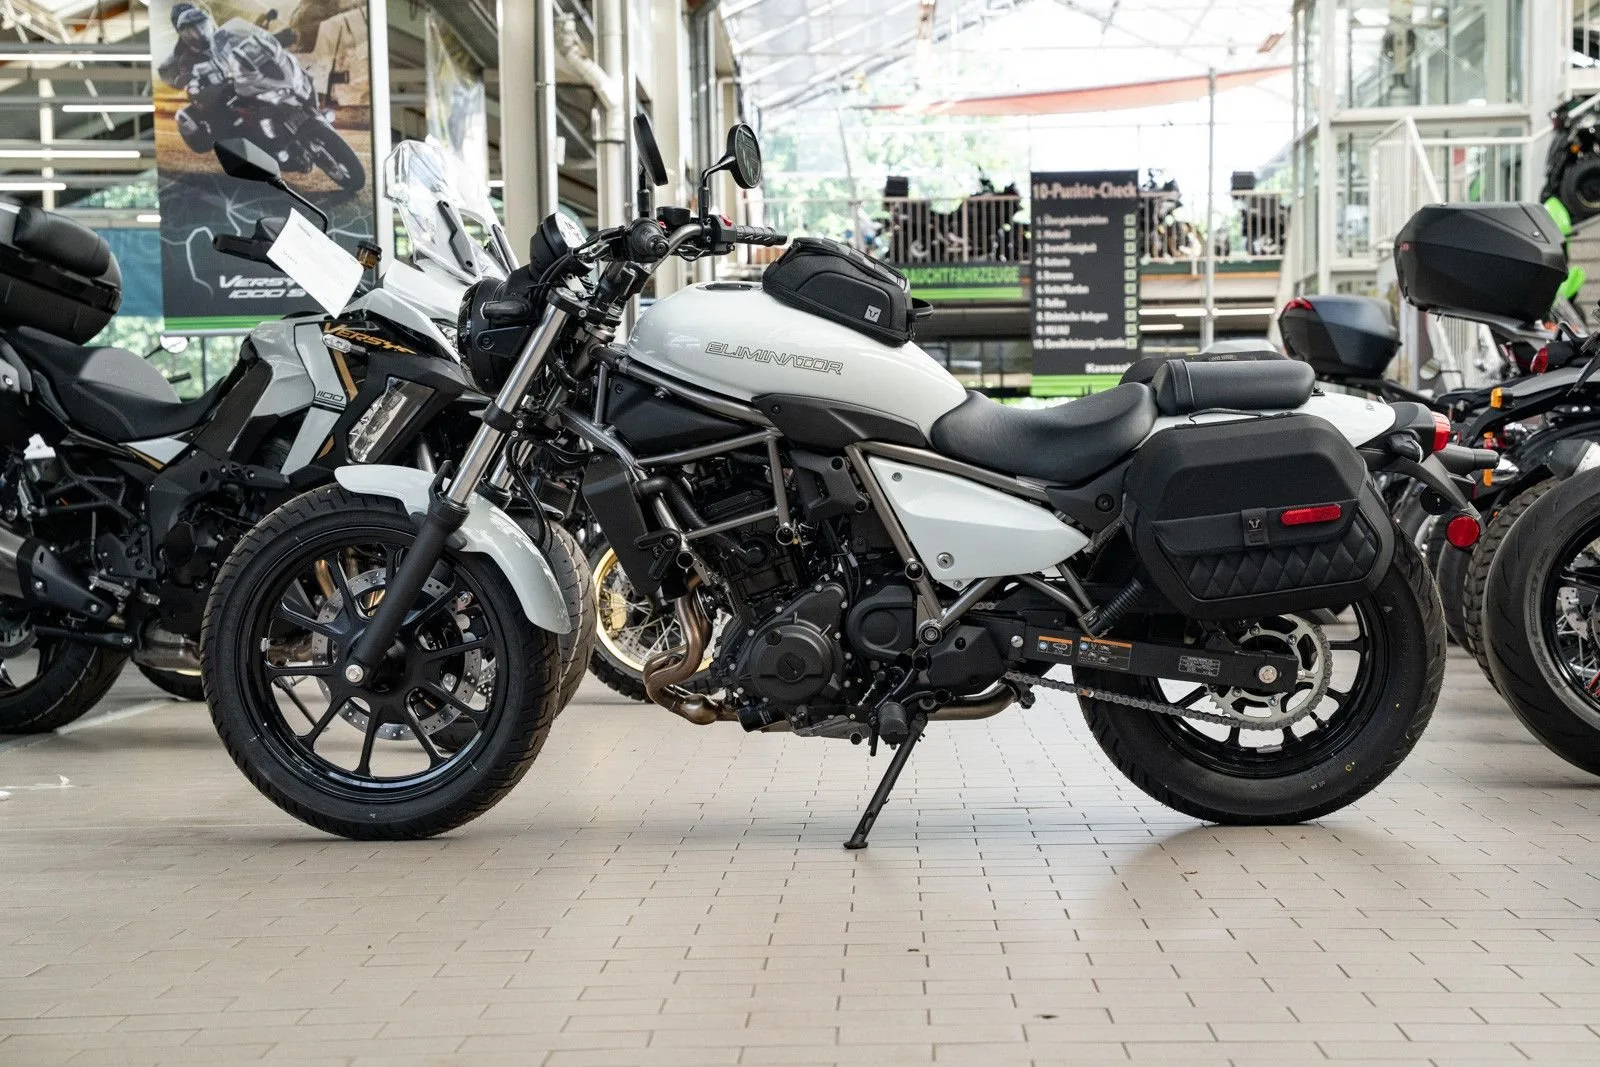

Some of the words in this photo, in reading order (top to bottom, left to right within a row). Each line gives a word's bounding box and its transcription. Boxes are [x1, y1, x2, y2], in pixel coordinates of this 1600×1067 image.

[219, 275, 297, 289] VERSY
[228, 289, 286, 299] 1000
[323, 322, 418, 355] VERSYS
[705, 341, 844, 376] ELIMINATOR
[316, 390, 344, 402] 1100
